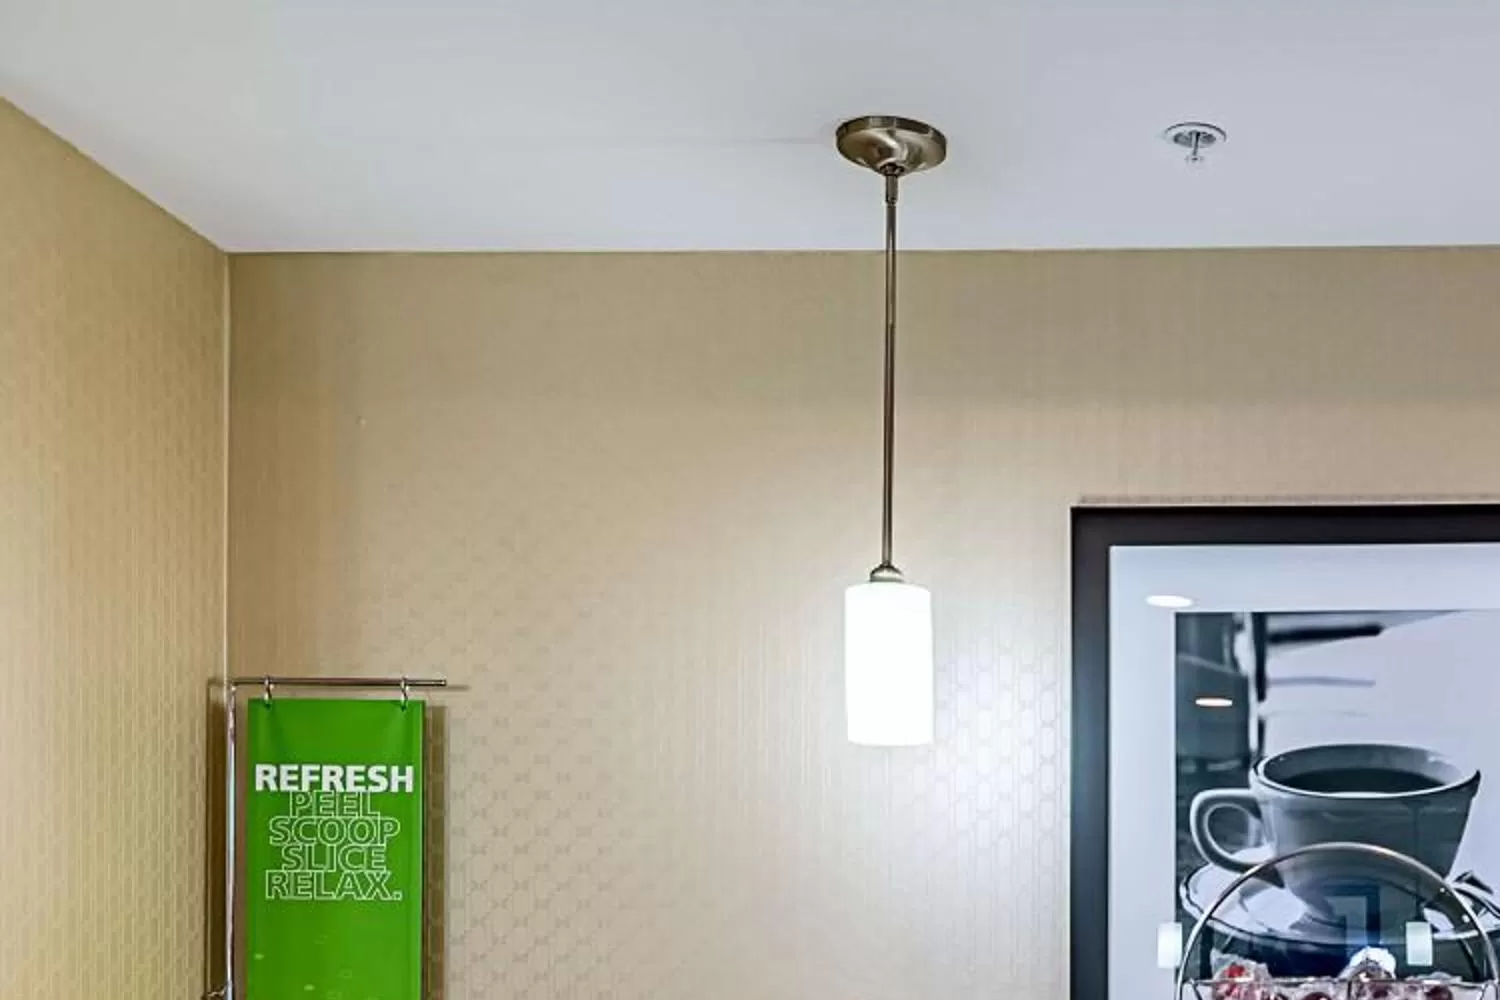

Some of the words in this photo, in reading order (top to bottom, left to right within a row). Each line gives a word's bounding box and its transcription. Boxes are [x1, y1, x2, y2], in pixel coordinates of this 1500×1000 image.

[255, 763, 415, 793] REFRESH
[290, 789, 380, 818] PEEL
[269, 815, 401, 846] SCOOP
[281, 844, 387, 873] SLICE
[265, 869, 404, 901] RELAX.
